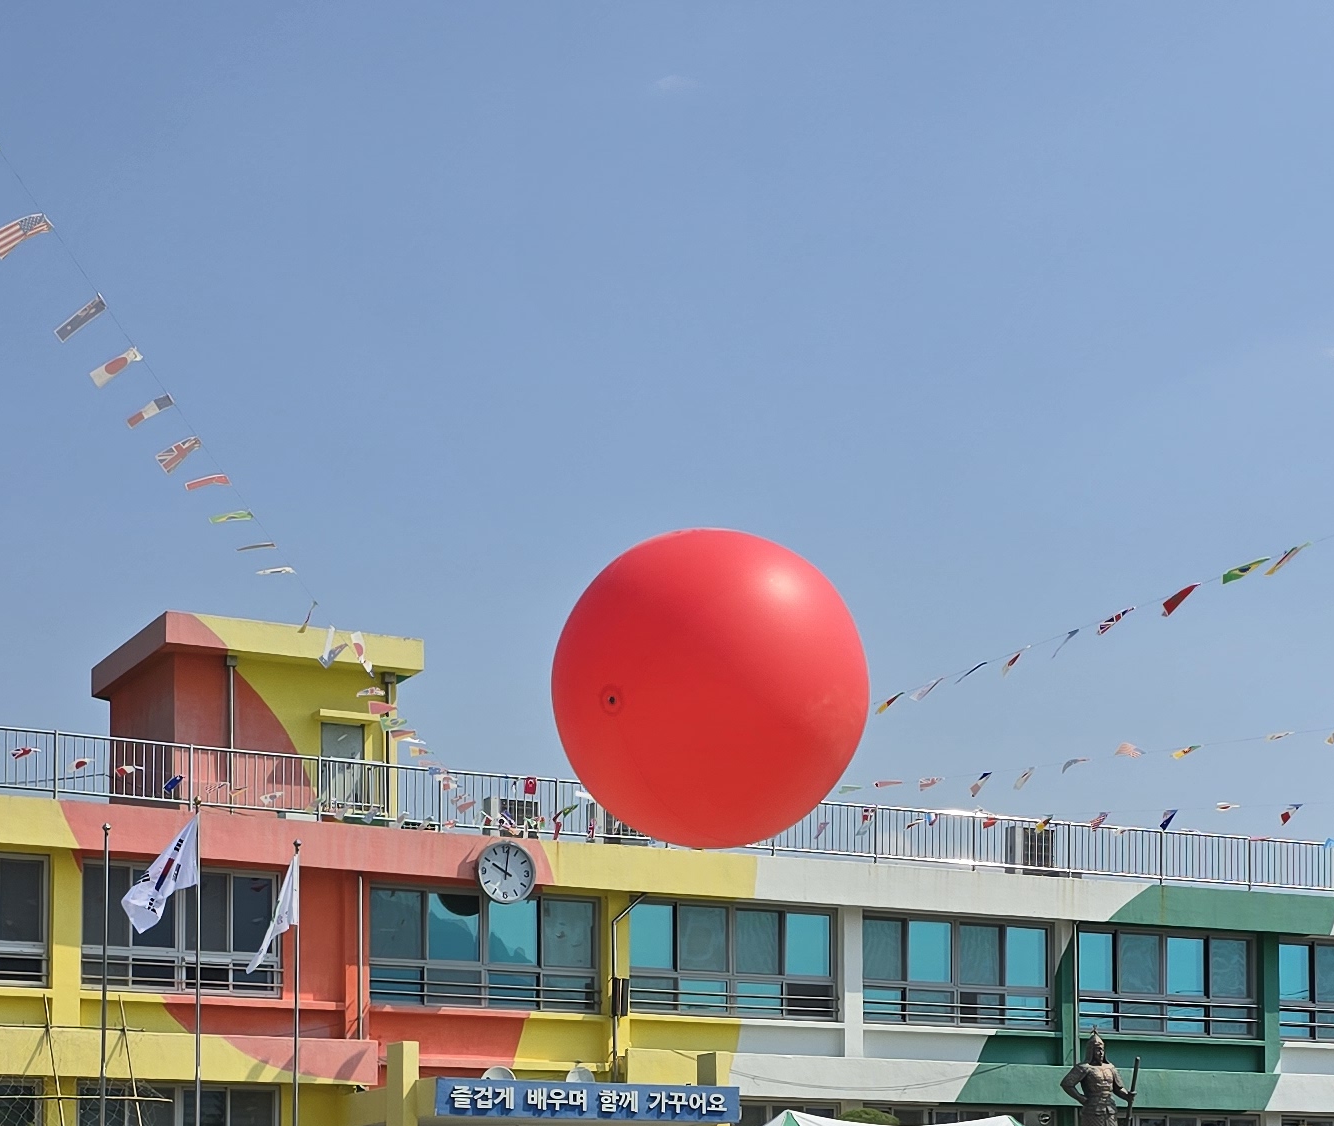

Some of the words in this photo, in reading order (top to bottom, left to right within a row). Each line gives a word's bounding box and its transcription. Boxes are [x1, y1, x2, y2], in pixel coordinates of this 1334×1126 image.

[501, 845, 510, 854] 12
[481, 867, 487, 875] 9
[523, 870, 530, 878] 3
[502, 891, 509, 899] 6
[450, 1085, 515, 1110] 즐겁게
[526, 1088, 588, 1112] 배우며
[598, 1090, 638, 1113] 함께
[649, 1091, 727, 1114] 가꾸어요
